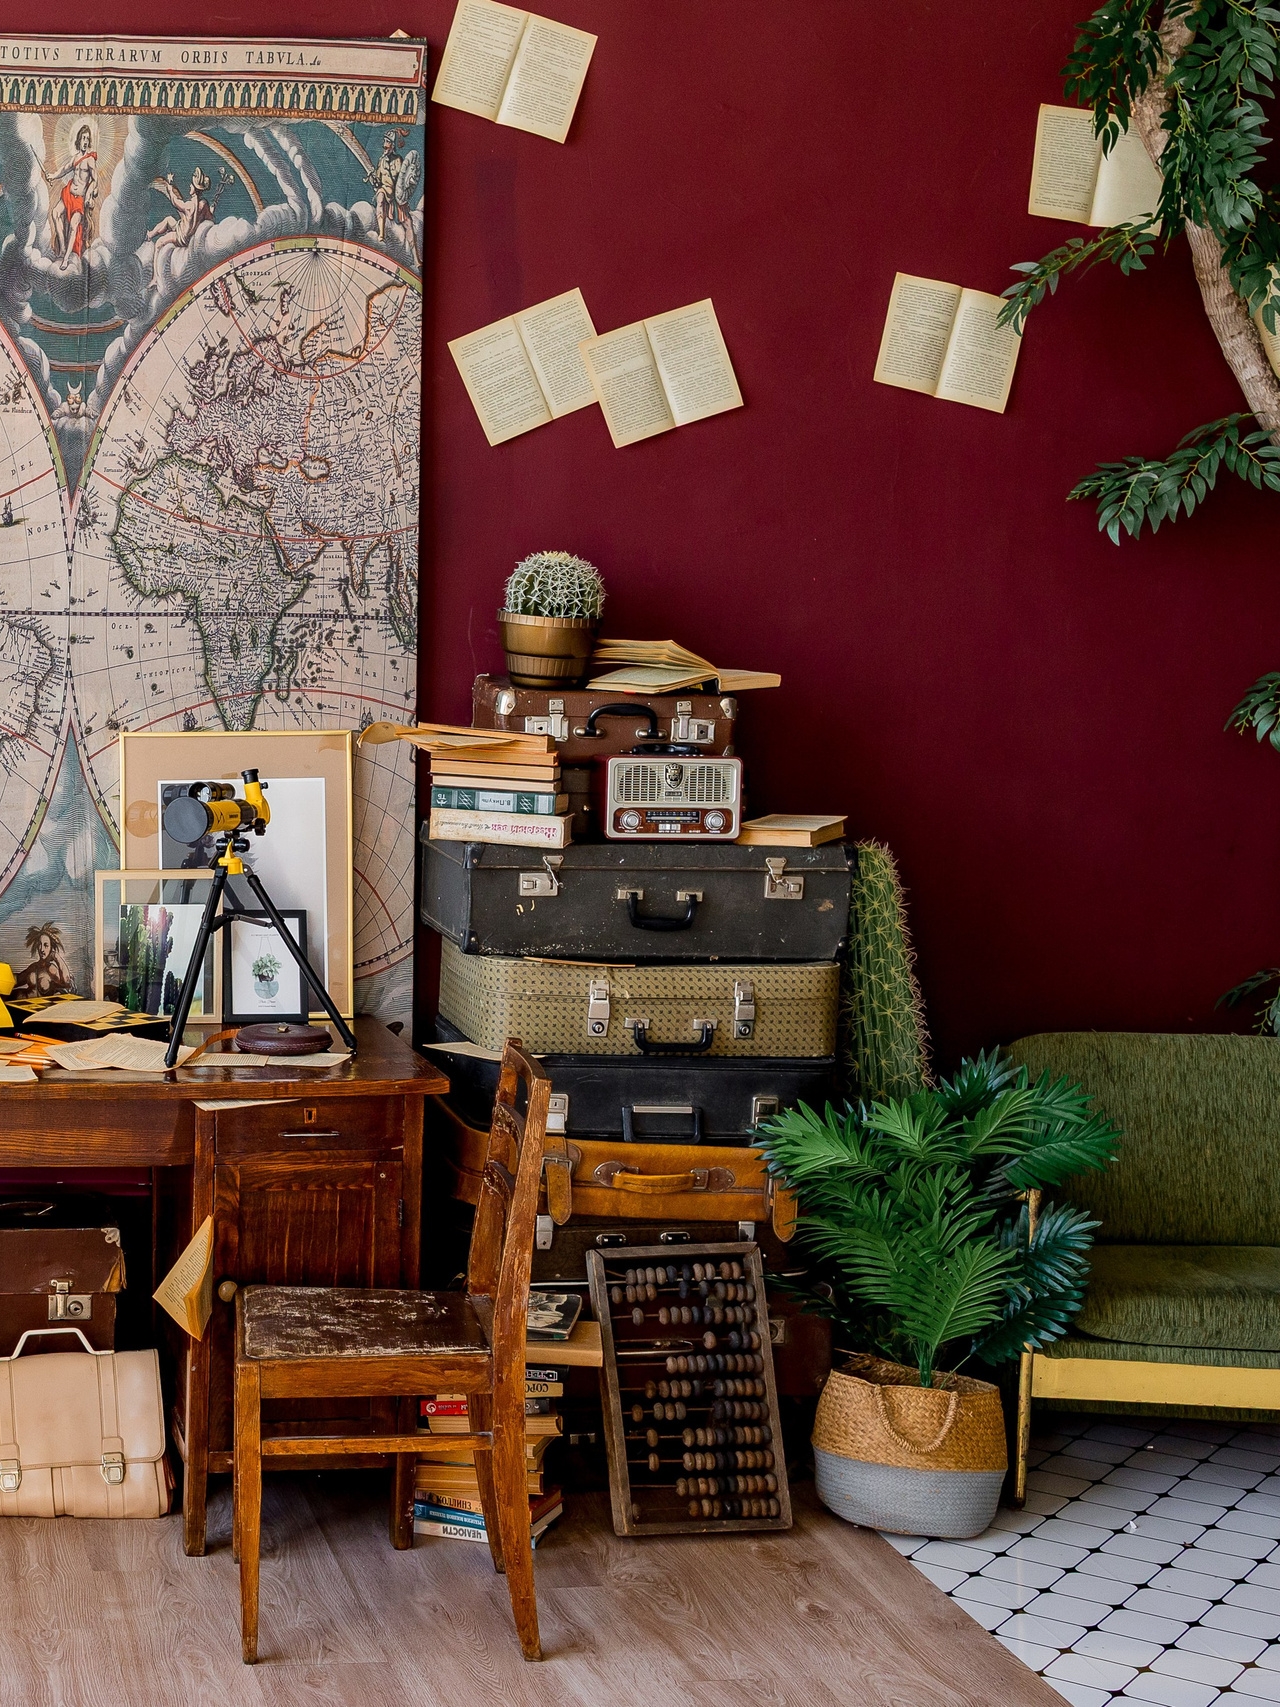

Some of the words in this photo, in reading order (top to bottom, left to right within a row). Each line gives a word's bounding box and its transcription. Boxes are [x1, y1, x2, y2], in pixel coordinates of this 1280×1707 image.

[0, 45, 61, 60] TOTIVS
[75, 47, 163, 63] TERRARVM
[180, 50, 229, 65] ORBIS
[436, 1494, 472, 1510] КОЛЛИНЗ
[442, 1525, 482, 1540] ЧЕЛЮСТИ
